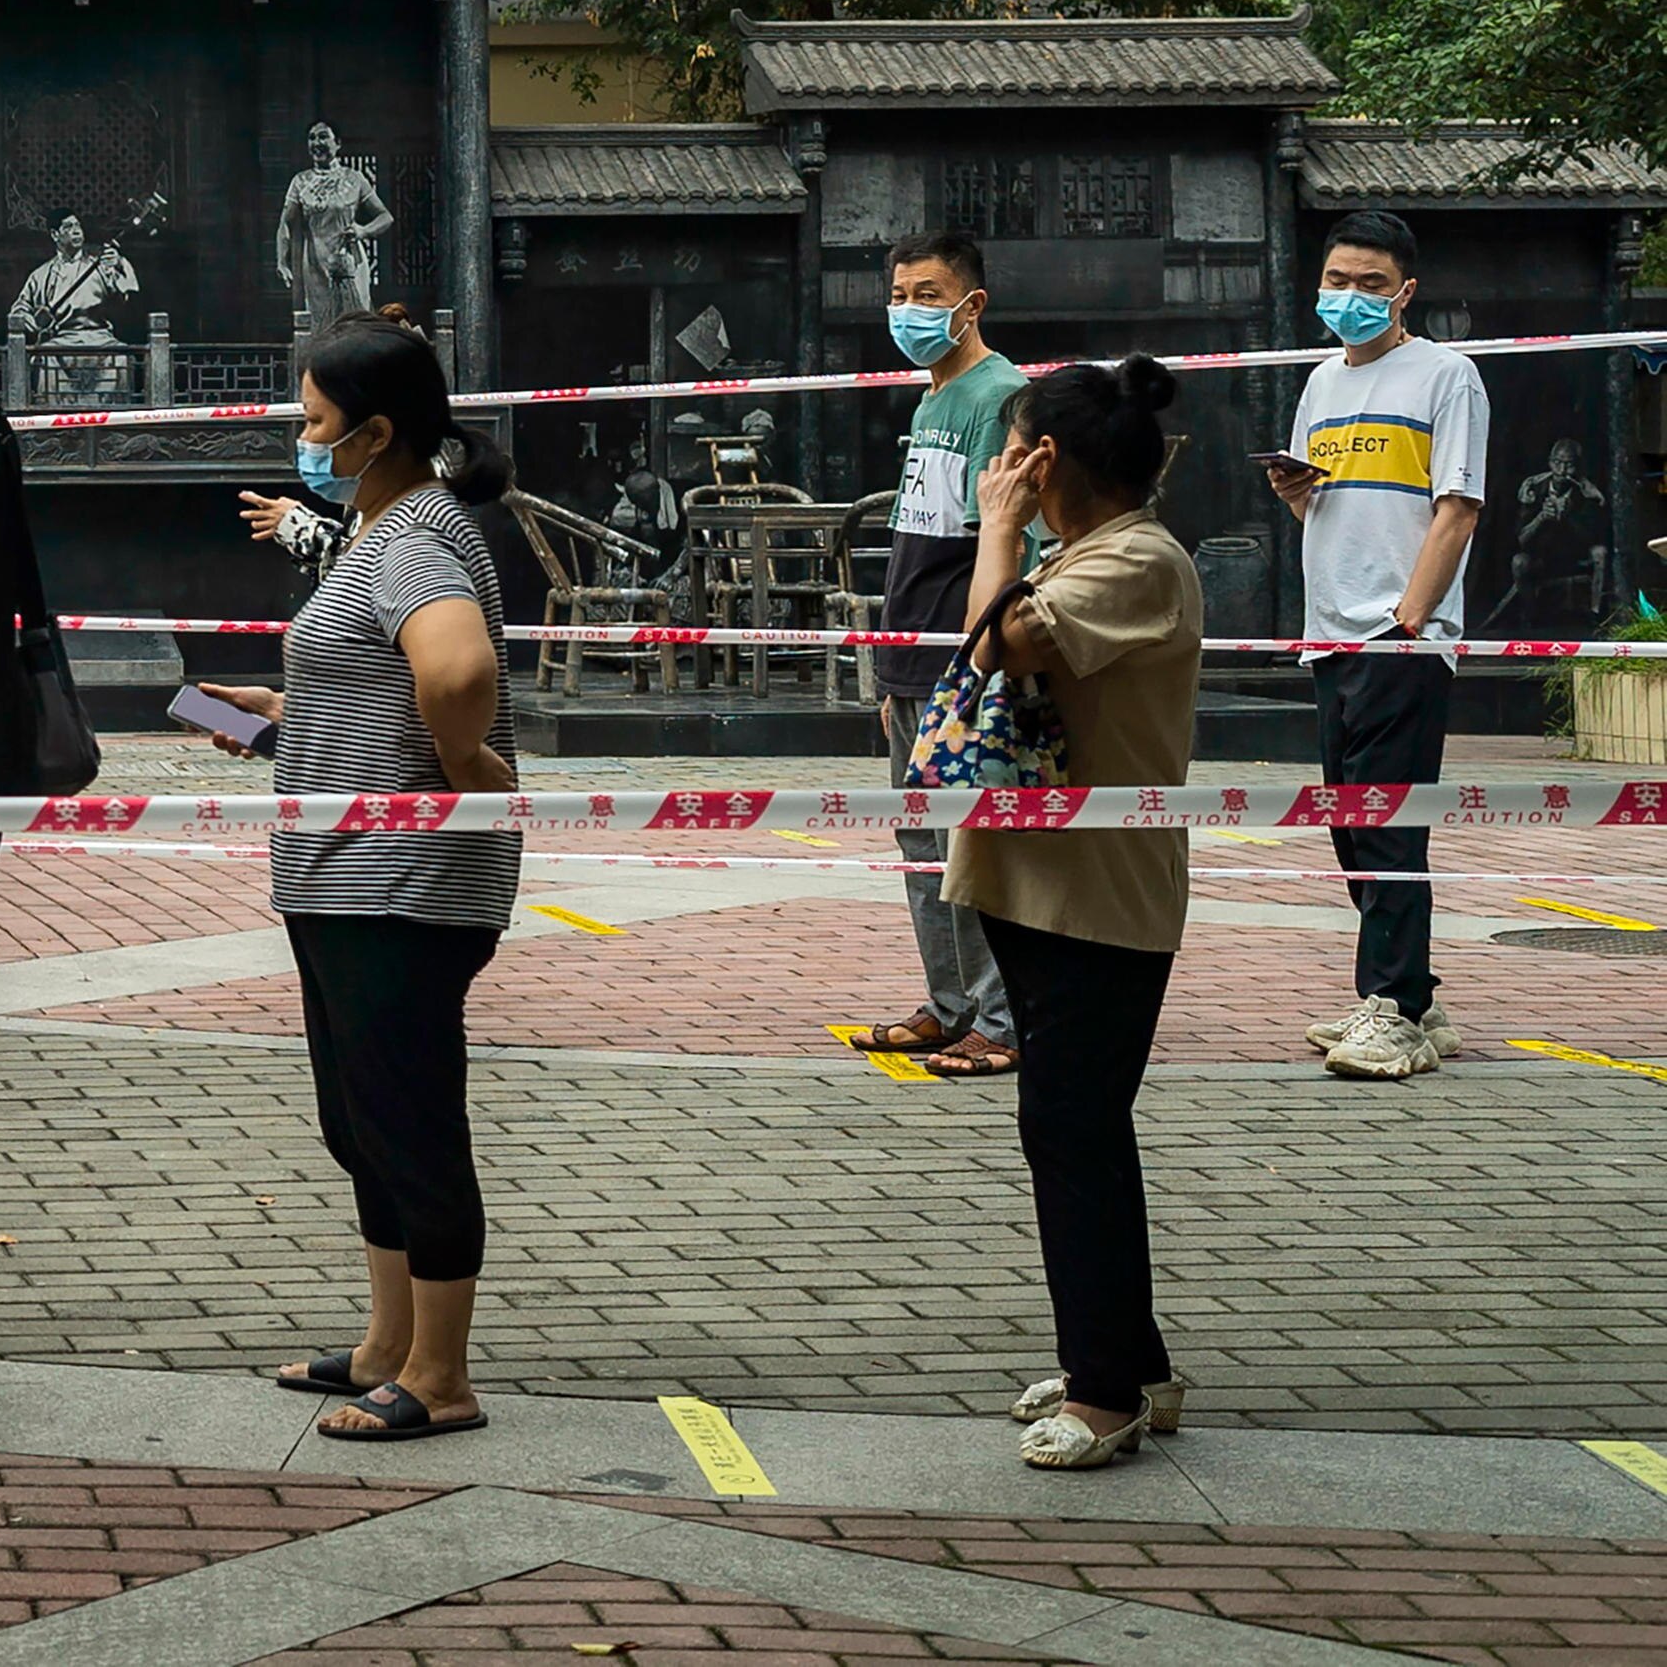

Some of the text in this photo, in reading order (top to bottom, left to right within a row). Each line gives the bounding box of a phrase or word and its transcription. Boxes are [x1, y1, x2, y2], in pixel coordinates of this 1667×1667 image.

[528, 630, 609, 640] CAUTION
[643, 631, 700, 642] SAFE
[741, 630, 821, 641] CAUTION
[53, 798, 130, 822] 安全
[194, 798, 305, 820] 注意
[363, 795, 440, 819] 安全
[506, 795, 615, 818] 注意
[676, 793, 753, 816] 安全
[820, 792, 930, 815] 注意
[992, 790, 1070, 814] 安全
[1137, 788, 1249, 812] 注意
[1310, 786, 1389, 811] 安全
[1458, 785, 1571, 810] 注意
[181, 821, 296, 832] CAUTION
[350, 820, 428, 831] SAFE
[492, 819, 608, 830] CAUTION
[662, 818, 742, 829] SAFE
[806, 816, 923, 828] CAUTION
[977, 815, 1058, 827] SAFE
[1122, 814, 1242, 826] CAUTION
[1296, 813, 1377, 825] SAFE
[1443, 812, 1564, 825] CAUTION
